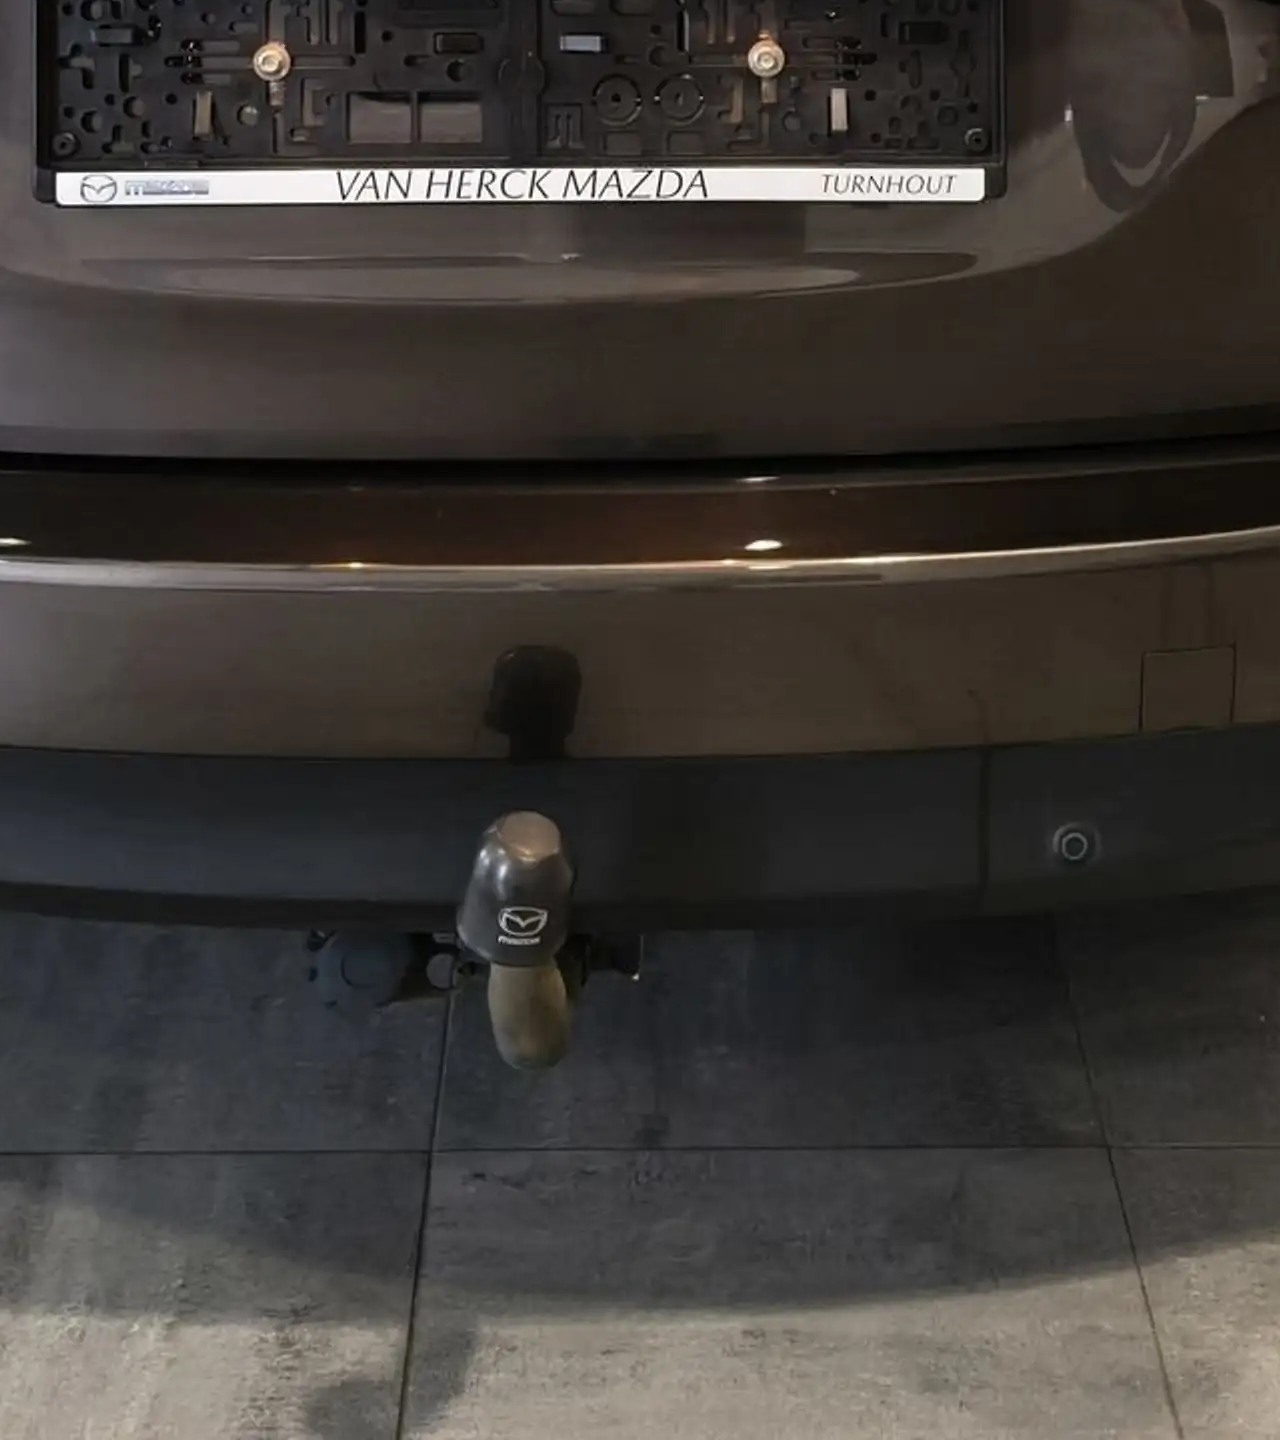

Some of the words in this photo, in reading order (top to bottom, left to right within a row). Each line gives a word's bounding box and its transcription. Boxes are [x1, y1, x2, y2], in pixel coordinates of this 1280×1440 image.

[336, 169, 412, 201] VAN
[425, 169, 552, 200] HERCK
[562, 168, 709, 200] MAZDA
[822, 173, 958, 195] TURNHOUT
